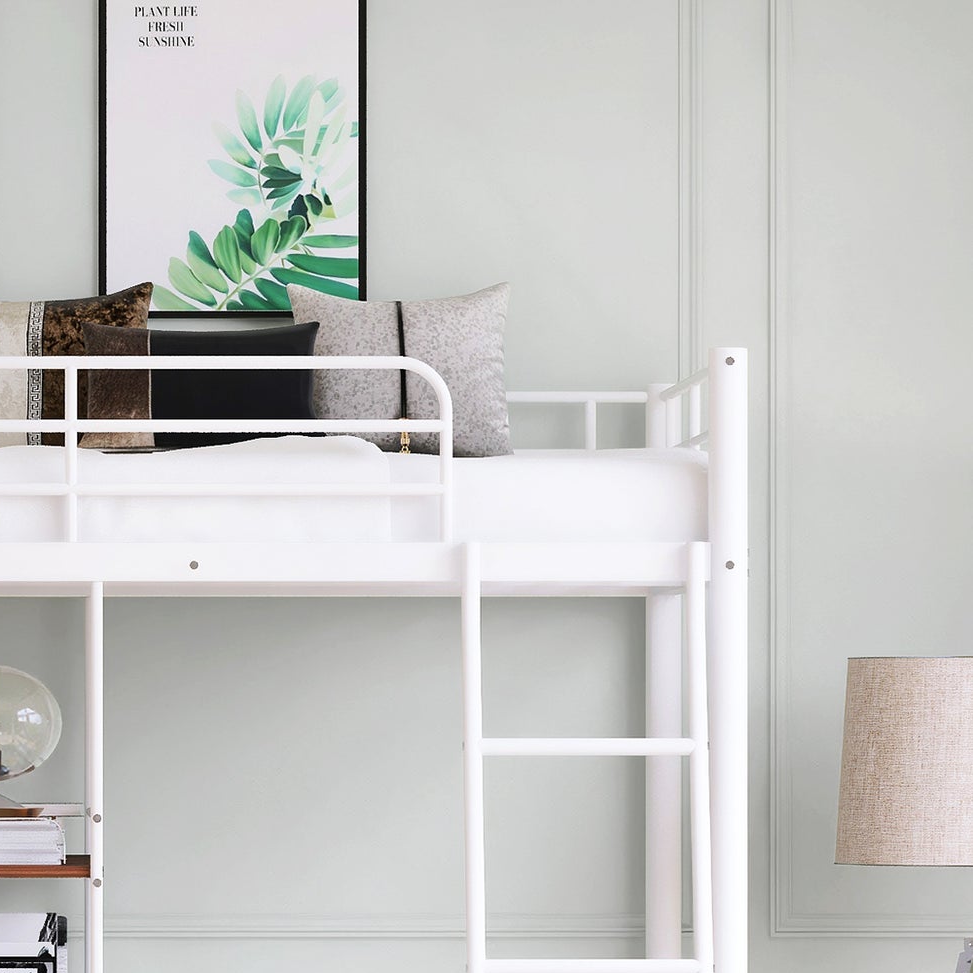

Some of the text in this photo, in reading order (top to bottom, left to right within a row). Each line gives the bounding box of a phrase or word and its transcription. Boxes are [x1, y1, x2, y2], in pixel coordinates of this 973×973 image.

[134, 6, 198, 17] PLANT LIFE
[148, 21, 184, 32] FRESH
[138, 35, 195, 47] SUNSHINE
